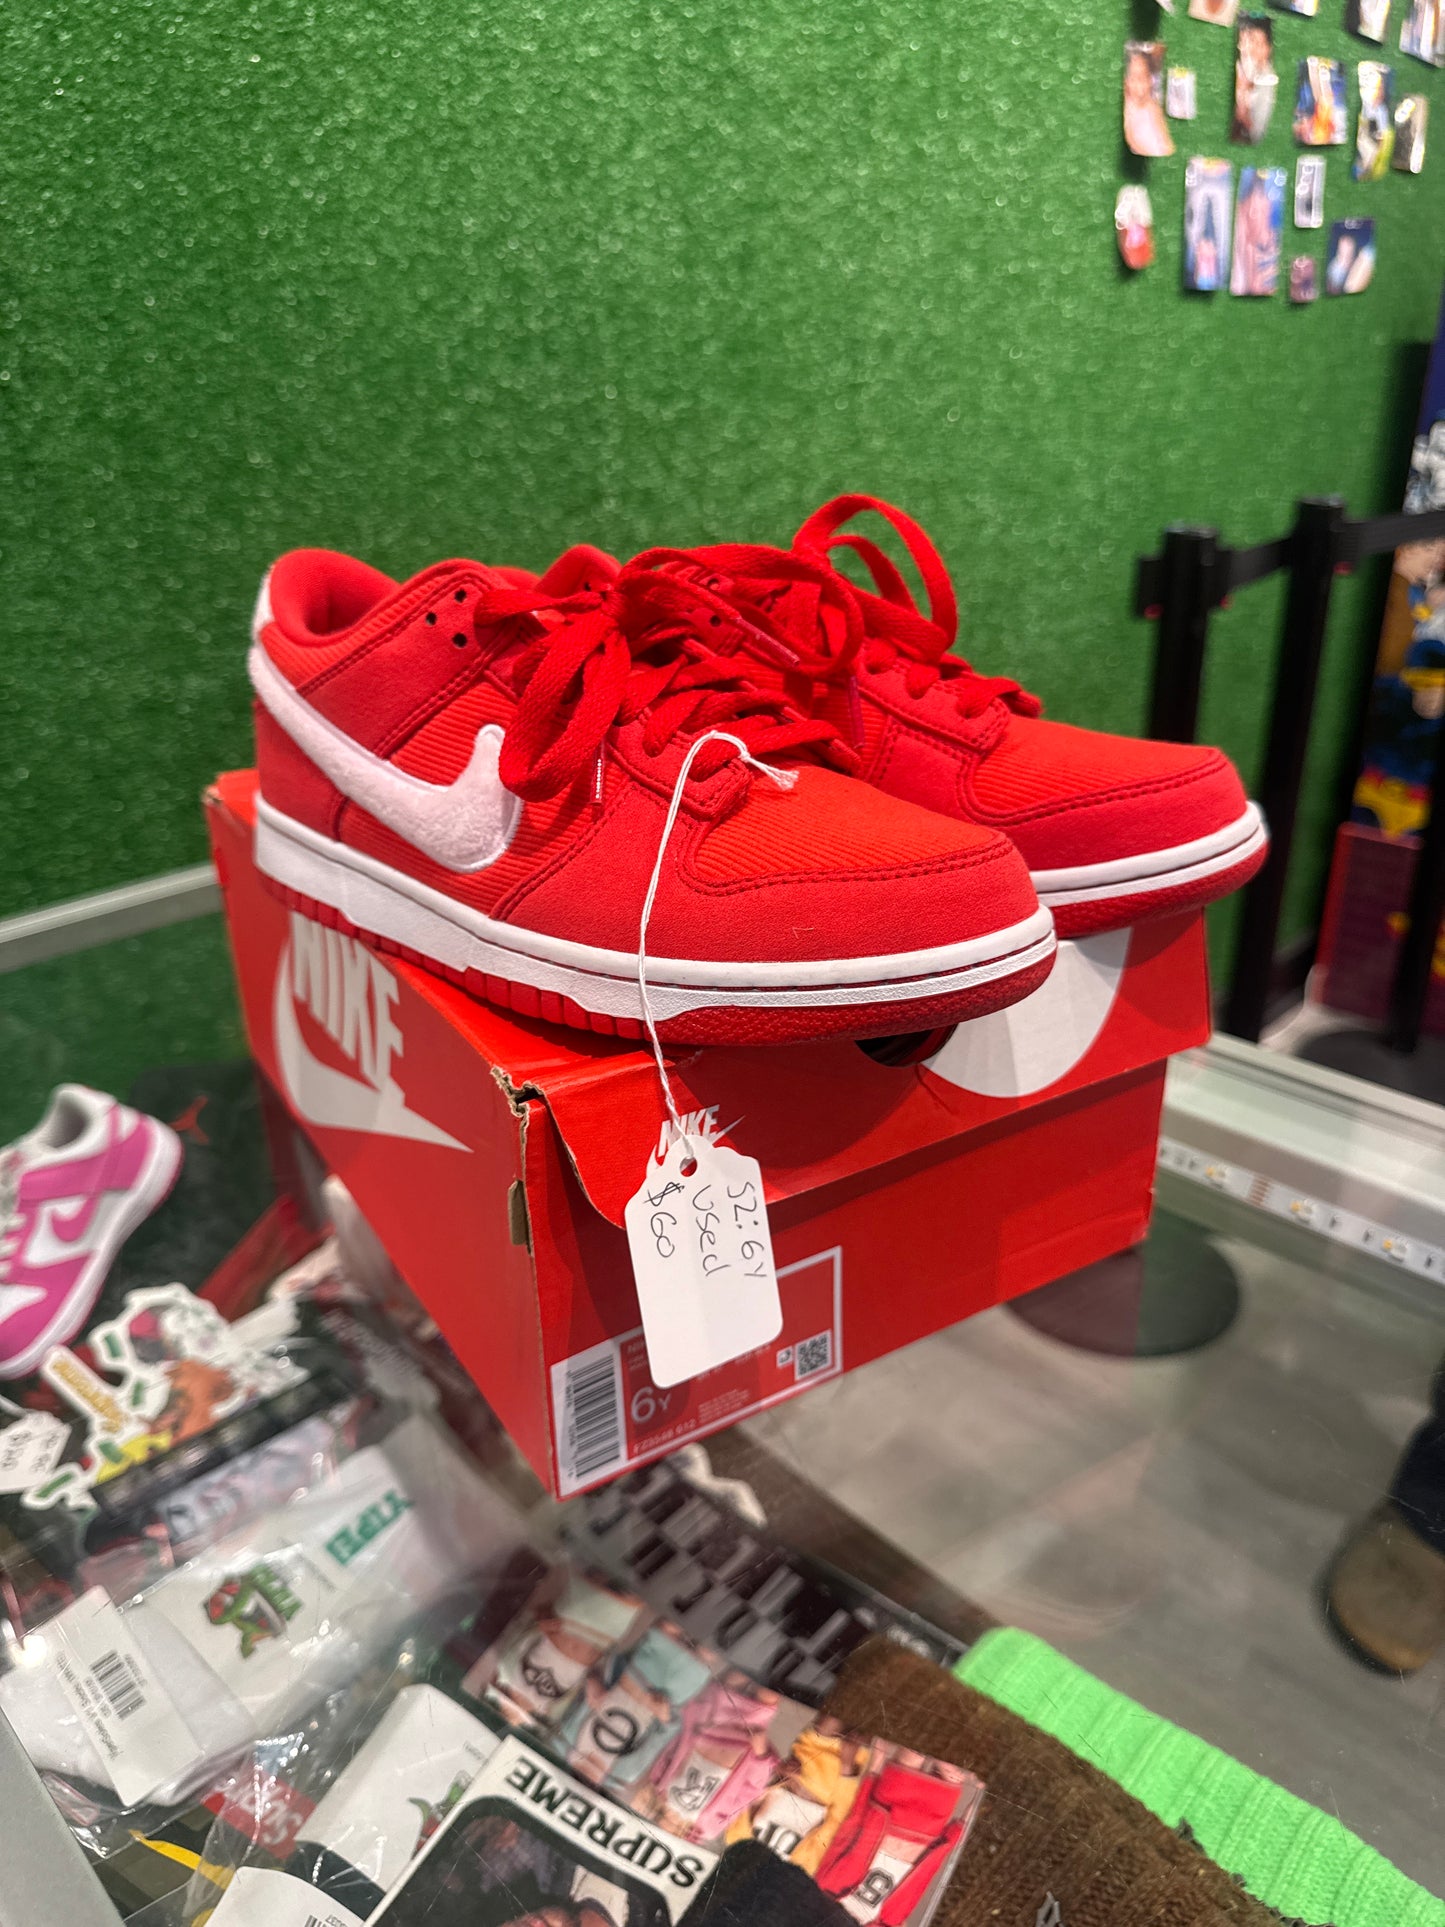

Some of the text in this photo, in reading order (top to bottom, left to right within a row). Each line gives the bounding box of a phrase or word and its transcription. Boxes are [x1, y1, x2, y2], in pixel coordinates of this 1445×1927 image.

[291, 911, 406, 1108] NIKE
[657, 1104, 721, 1158] NIKE
[643, 1181, 686, 1259] $60
[692, 1184, 732, 1277] Used
[495, 1754, 705, 1888] SUPREME
